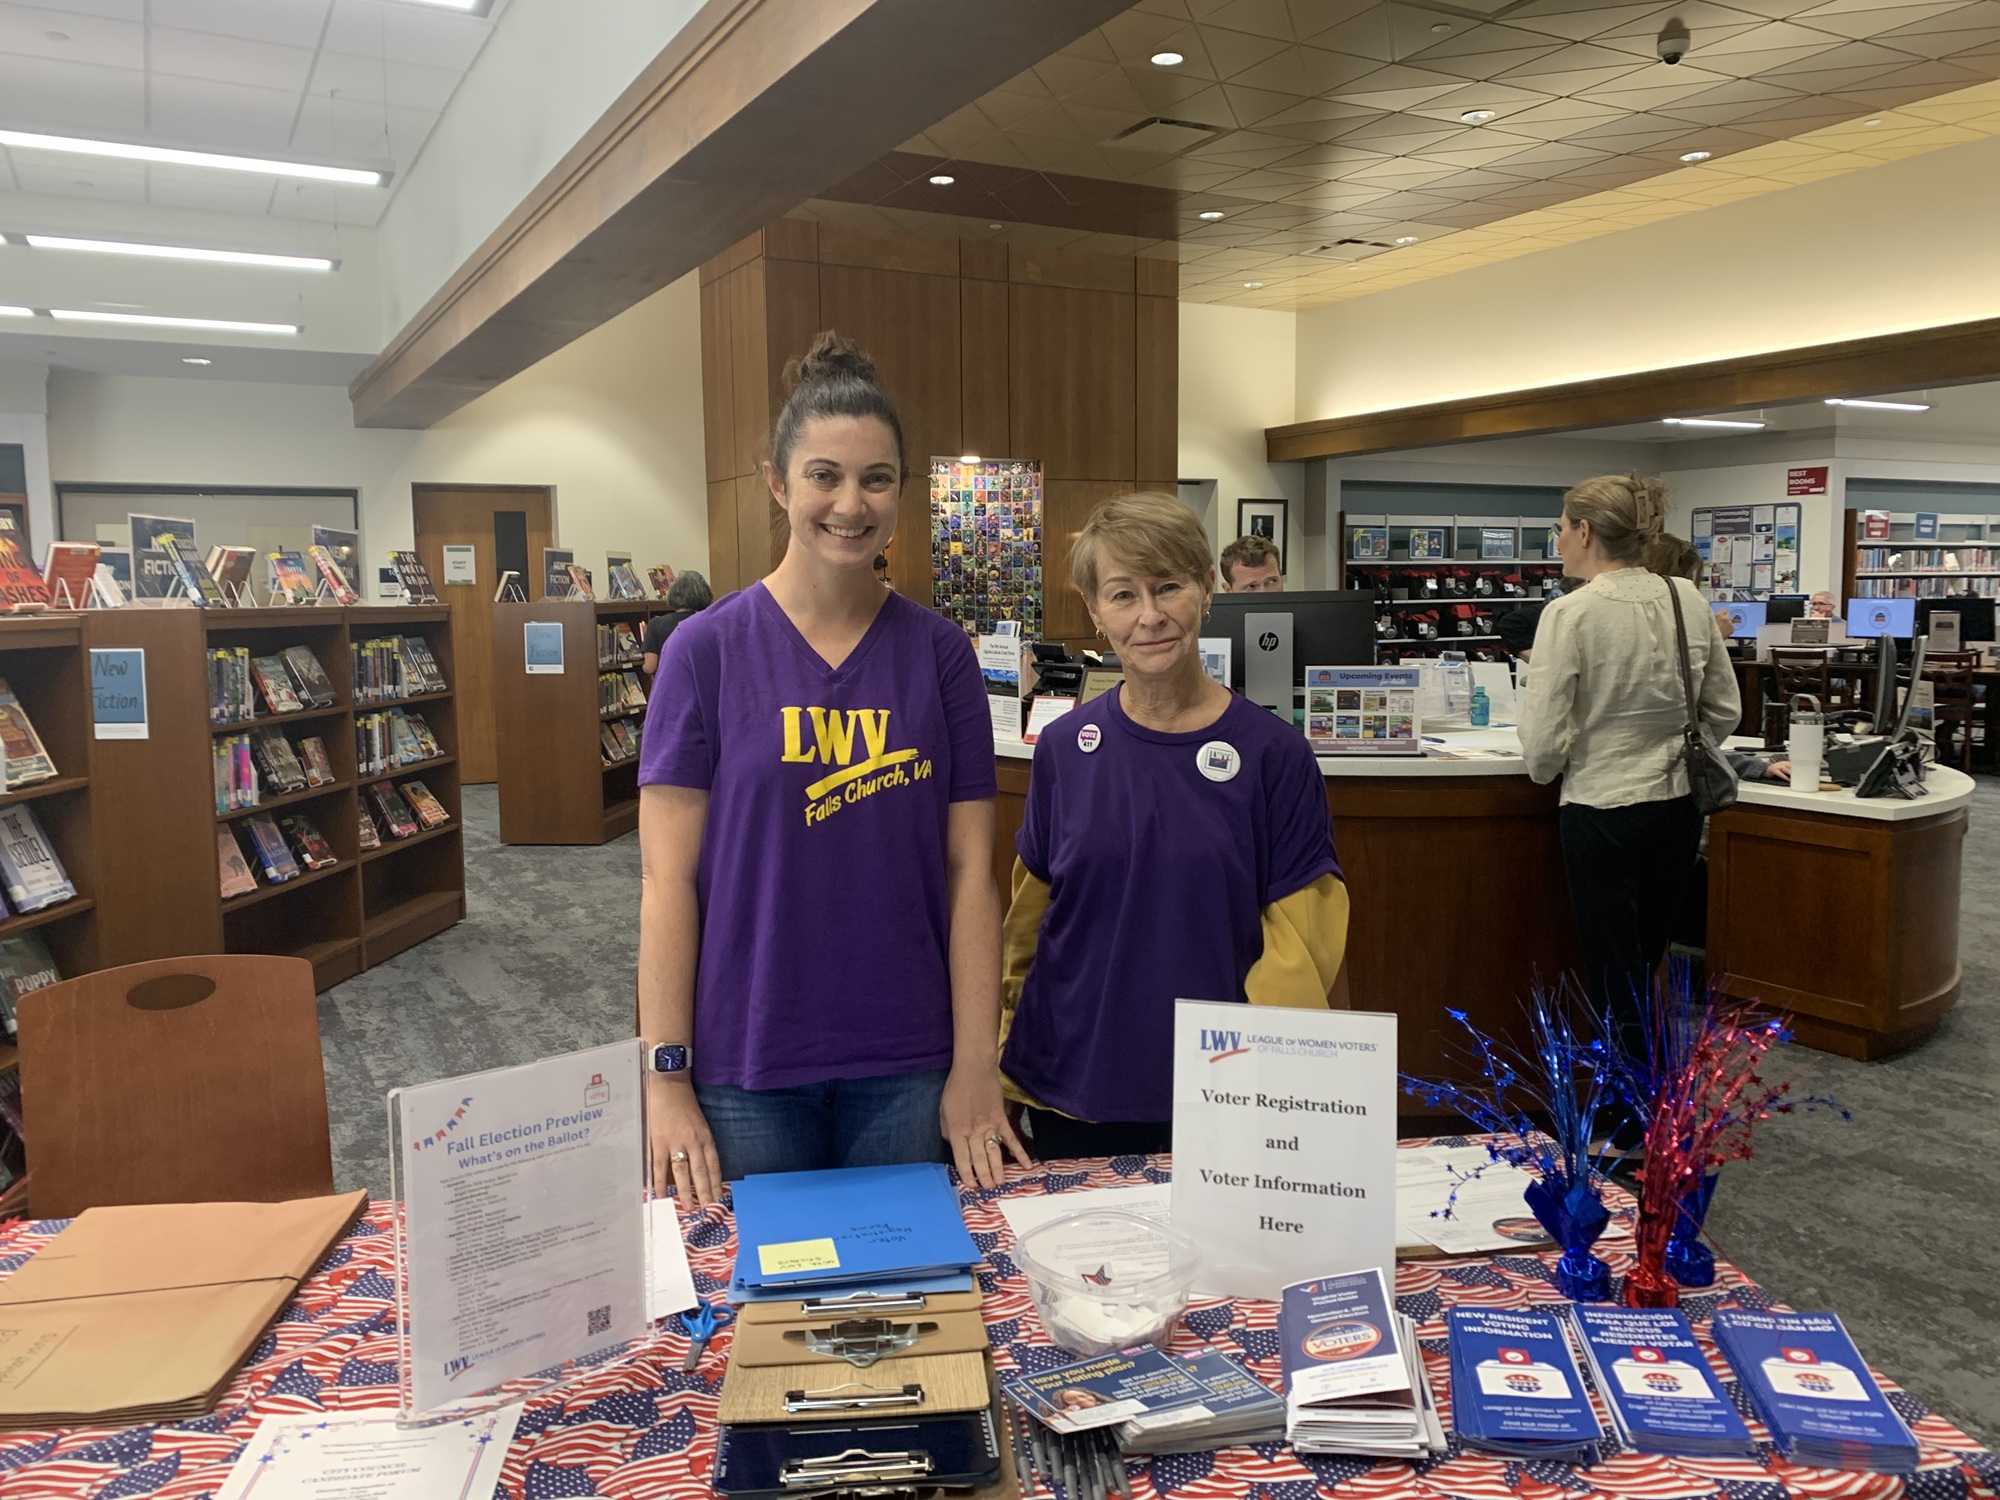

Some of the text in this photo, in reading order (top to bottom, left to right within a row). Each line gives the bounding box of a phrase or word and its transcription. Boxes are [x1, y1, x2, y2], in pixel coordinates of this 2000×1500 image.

[1788, 477, 1816, 485] ROOMS
[1715, 509, 1750, 517] Community
[400, 553, 417, 564] THE
[400, 564, 427, 575] DEATH
[6, 571, 20, 584] OF
[549, 574, 570, 585] FICTION
[0, 585, 49, 604] ASHES
[534, 627, 553, 640] New
[1261, 634, 1277, 651] hp
[94, 655, 129, 677] New
[1340, 672, 1382, 681] Upcoming
[780, 706, 891, 765] LWV
[804, 759, 932, 827] Falls Church, VA
[2, 813, 29, 842] THE
[7, 836, 51, 869] SEQUEL
[14, 968, 57, 995] POPPY
[1200, 1029, 1242, 1051] LWV
[1247, 1034, 1284, 1046] LEAGUE
[1297, 1038, 1337, 1049] WOMEN
[1257, 1044, 1338, 1059] OF FALLS CHURCH
[589, 1091, 606, 1101] VOTE
[1200, 1088, 1368, 1117] Voter Registration
[447, 1108, 604, 1155] Fall Election Preview
[458, 1128, 590, 1170] What's on the Ballot?
[1265, 1136, 1301, 1152] and
[1199, 1168, 1367, 1200] Voter Information
[1258, 1216, 1305, 1234] Here
[1311, 1290, 1358, 1302] Virginia Voter
[1312, 1298, 1337, 1306] Pocket
[1307, 1309, 1342, 1320] November
[1310, 1310, 1370, 1324] General Election
[1455, 1311, 1549, 1326] NEW RESIDENT
[1583, 1311, 1675, 1321] INFORMACIÓN
[1481, 1319, 1530, 1331] VOTING
[1585, 1318, 1680, 1328] PARA QUE LOS
[1608, 1325, 1663, 1334] NUEVOS
[1463, 1325, 1553, 1340] INFORMATION
[1599, 1331, 1680, 1341] RESIDENTES
[1313, 1332, 1372, 1349] VOTERS
[1590, 1336, 1695, 1348] PUEDAN VOTAR
[1122, 1346, 1142, 1356] VOTE
[1183, 1351, 1203, 1359] VOTE
[444, 1356, 469, 1376] LWV
[1029, 1357, 1121, 1386] Have you made
[1036, 1361, 1136, 1393] your voting plan?
[1648, 1379, 1680, 1387] VOTE
